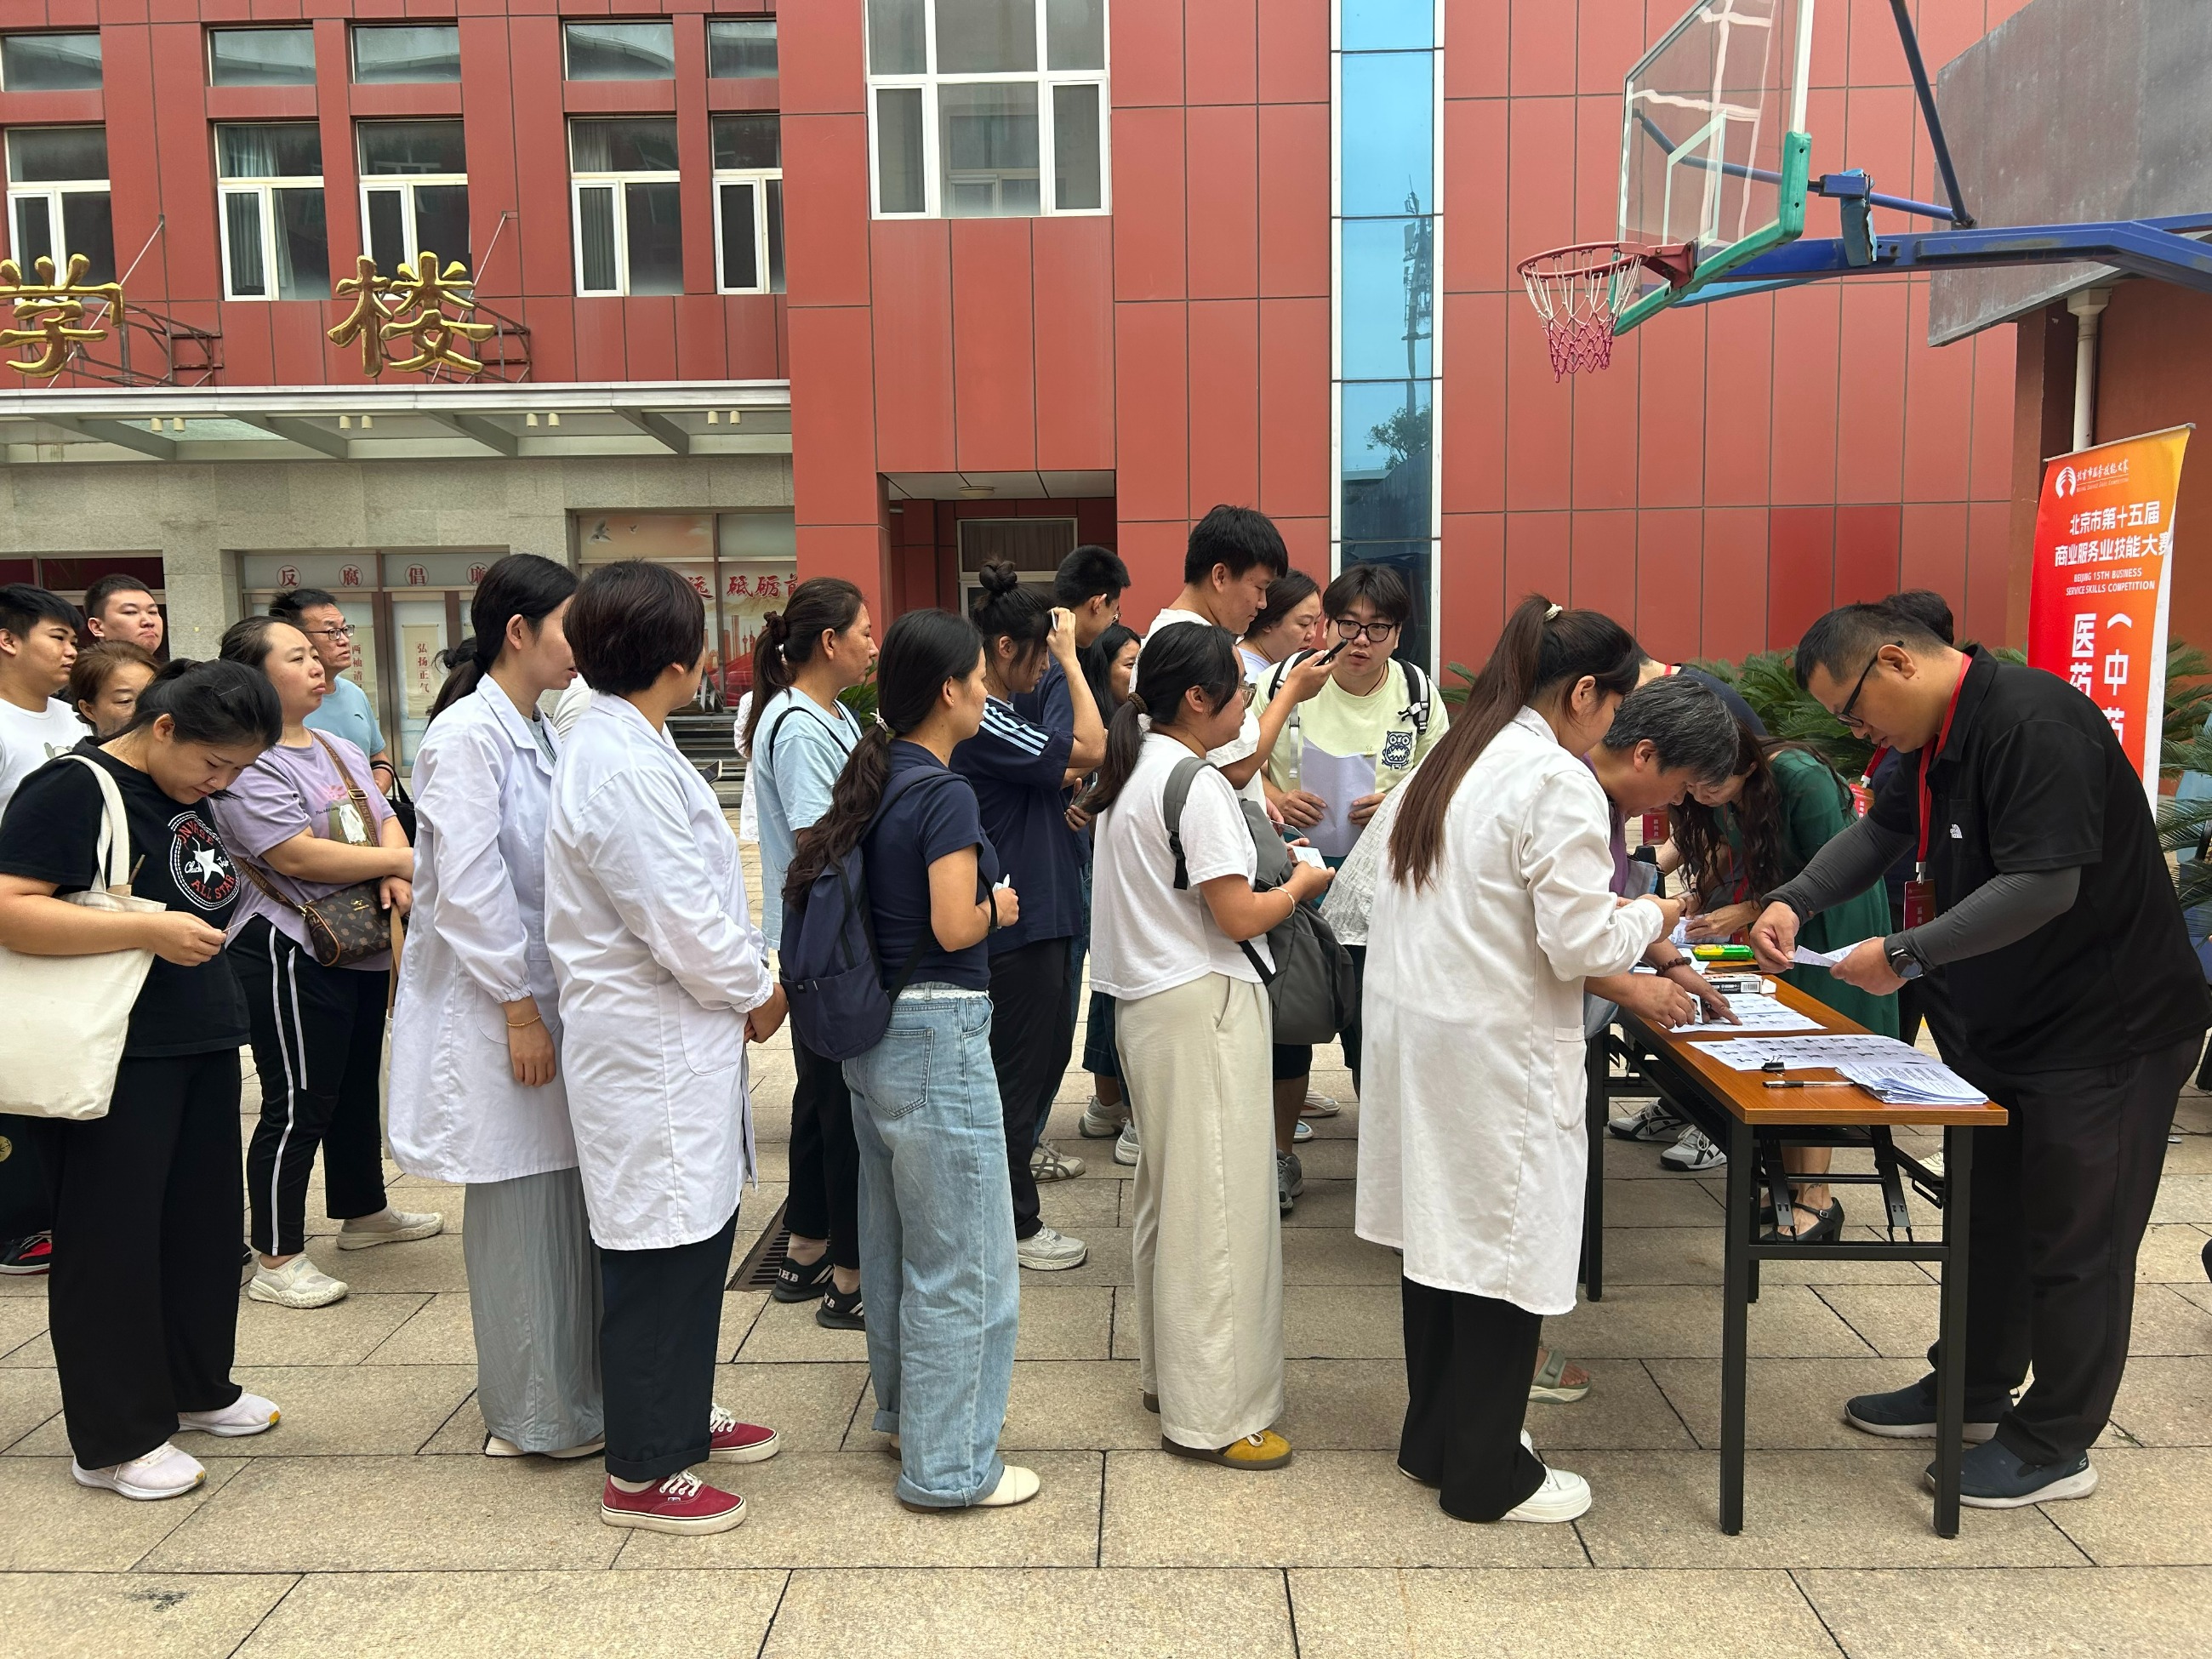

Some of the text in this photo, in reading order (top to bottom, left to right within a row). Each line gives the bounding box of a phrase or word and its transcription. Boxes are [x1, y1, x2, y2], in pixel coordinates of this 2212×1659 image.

[2069, 500, 2160, 536] 北京市第十五届
[2055, 531, 2171, 567] 商业服务业技能大赛
[2066, 580, 2156, 596] SERVICE SKILLS COMPETITION
[2093, 571, 2110, 581] 15TH
[2112, 567, 2142, 579] BUSINESS
[351, 644, 363, 688] 两袖清
[417, 642, 430, 693] 弘扬正气
[191, 874, 236, 900] ALL STAR
